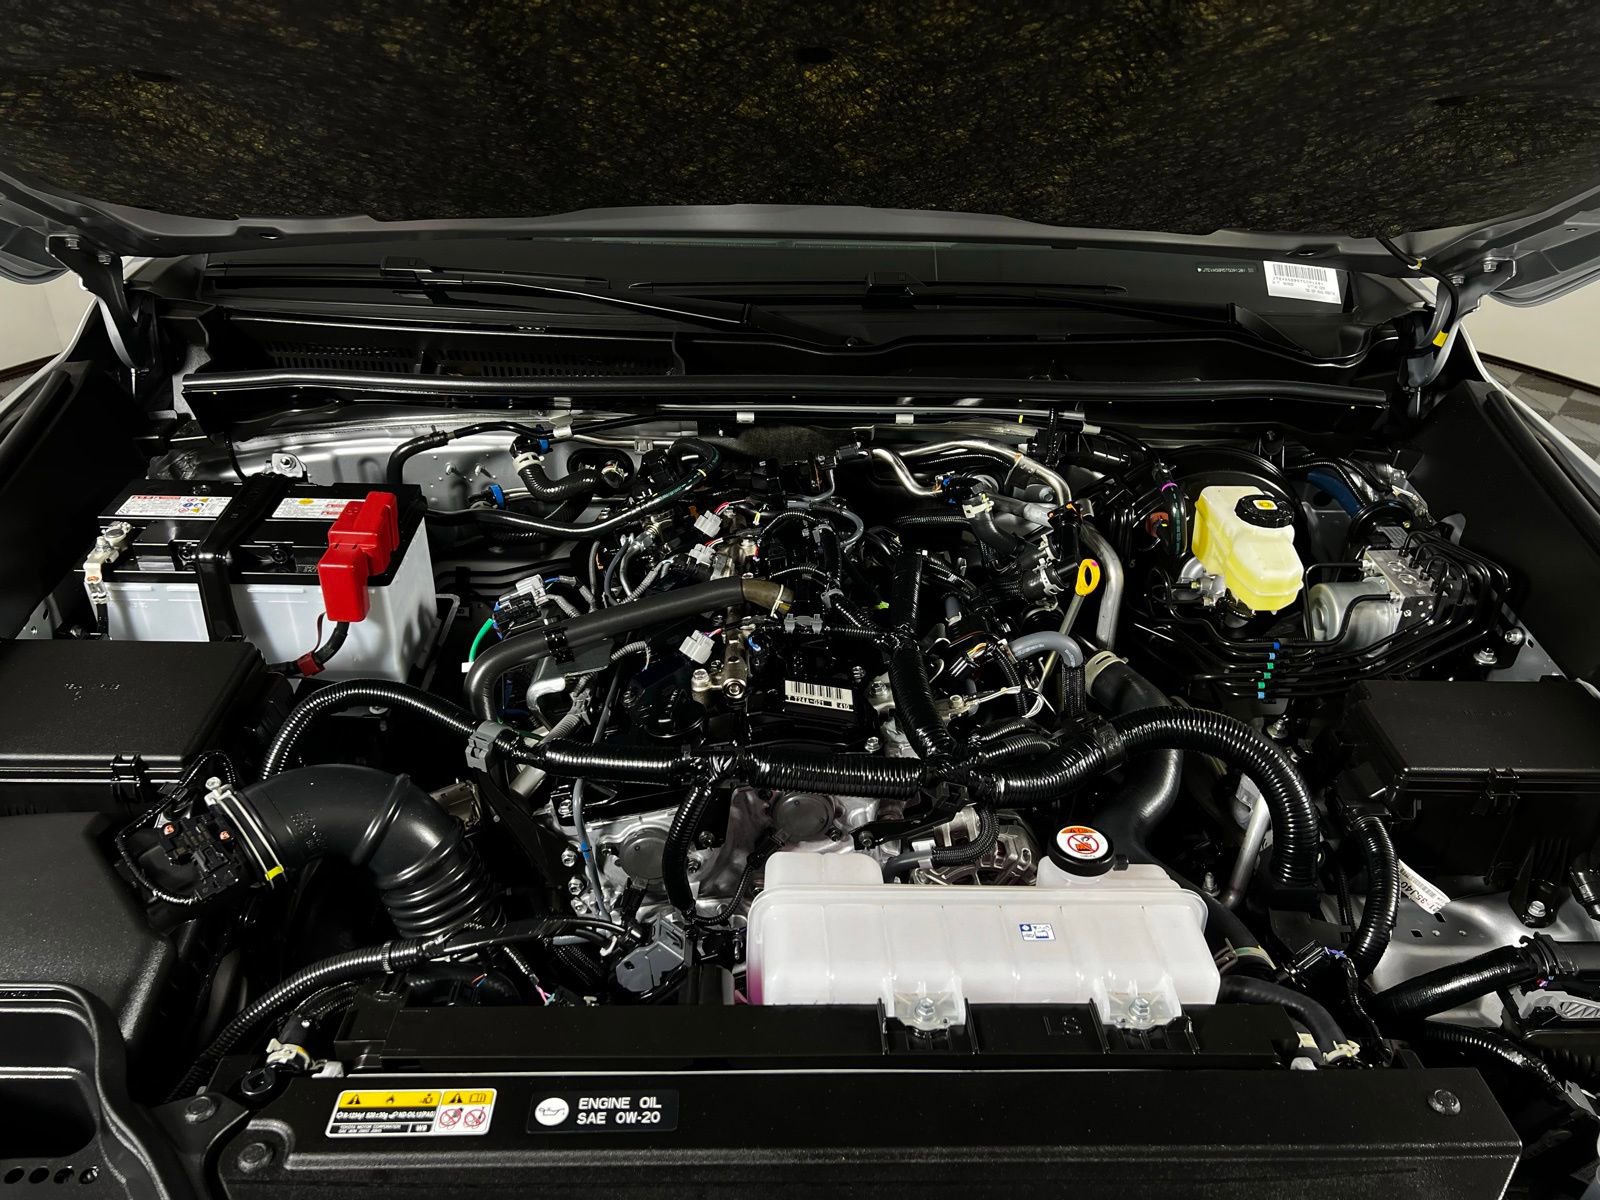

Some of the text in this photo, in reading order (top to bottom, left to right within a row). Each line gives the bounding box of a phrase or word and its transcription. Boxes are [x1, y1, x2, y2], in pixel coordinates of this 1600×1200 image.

[578, 1097, 662, 1109] ENGINE OIL
[576, 1111, 661, 1125] SAE 0W-20
